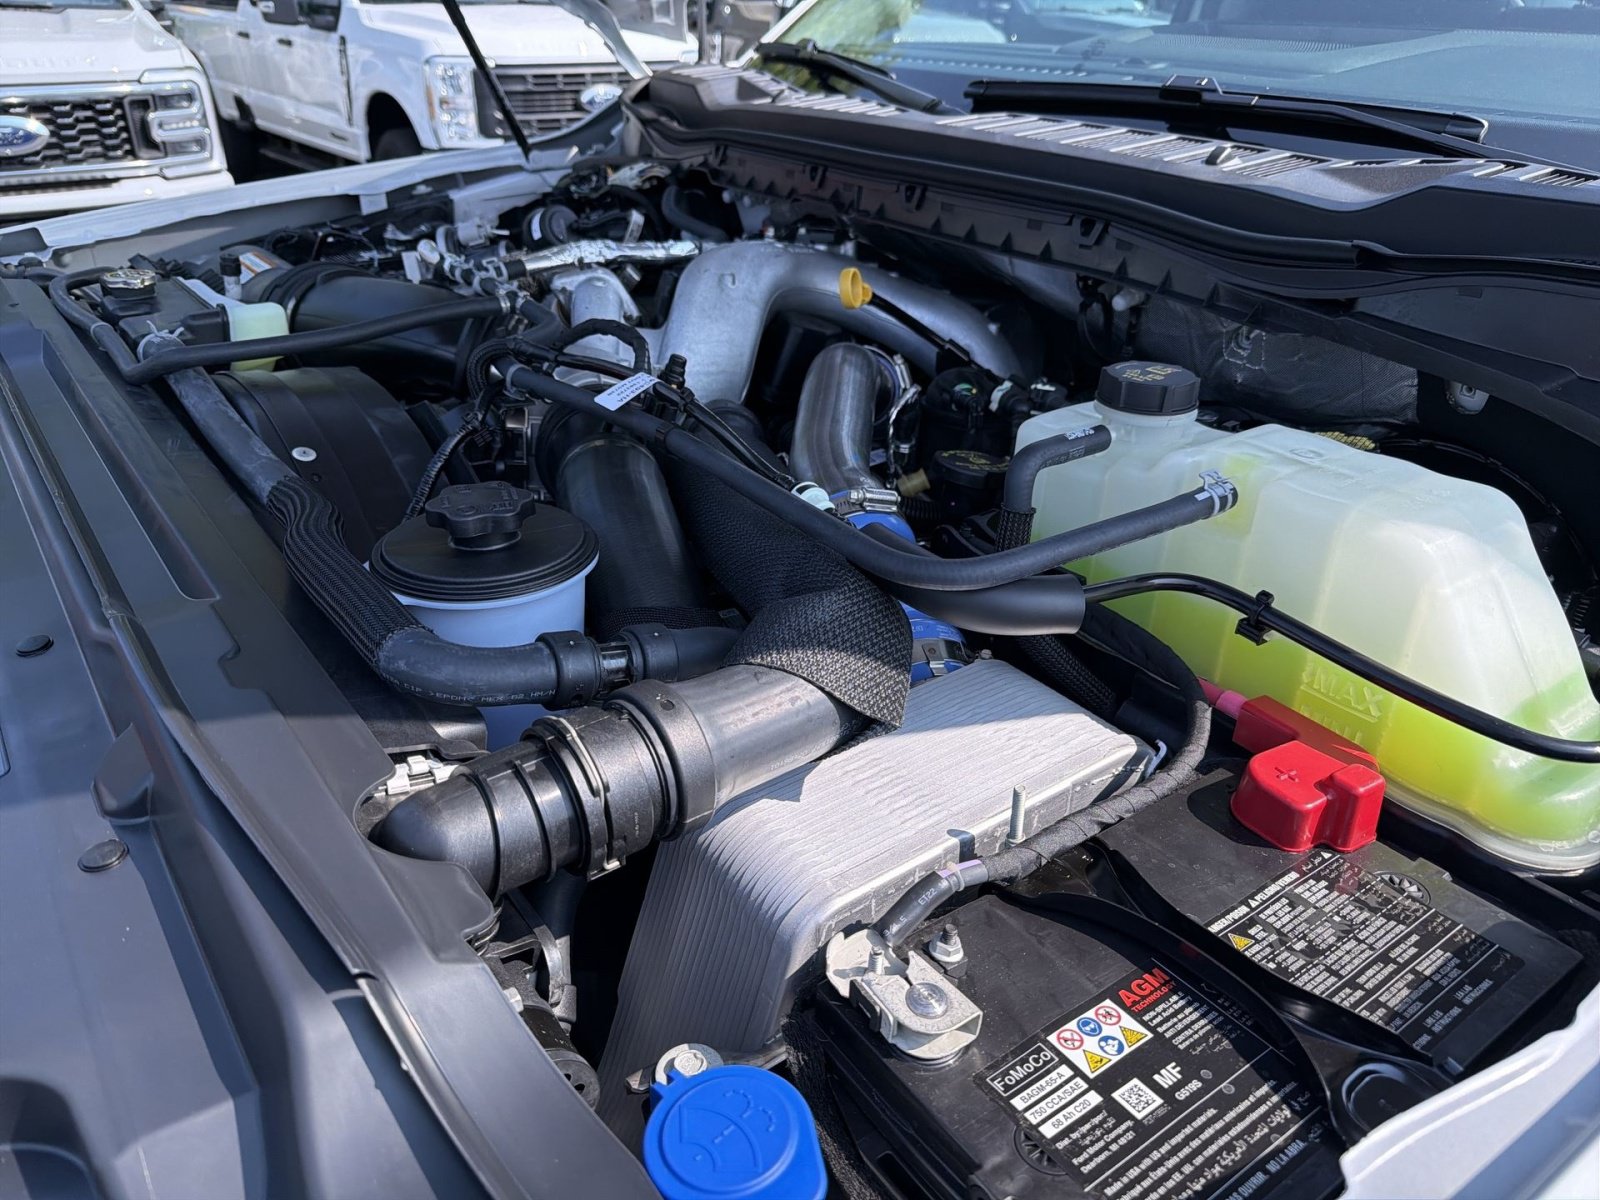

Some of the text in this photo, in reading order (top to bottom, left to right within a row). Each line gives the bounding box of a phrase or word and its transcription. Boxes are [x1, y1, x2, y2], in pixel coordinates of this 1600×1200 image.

[1313, 667, 1383, 718] MAX
[1207, 905, 1250, 934] ANGER/POISON
[1118, 968, 1169, 1007] AGM
[1131, 981, 1176, 1012] TECHNOLOGY
[1142, 992, 1184, 1021] NON-SPILLABLE
[993, 1051, 1051, 1091] FoMoCo
[1153, 1061, 1183, 1088] MF
[1020, 1072, 1065, 1103] BAGM-65-A
[1030, 1082, 1083, 1119] 750 CCA/SAE
[1175, 1080, 1202, 1100] G519S
[1052, 1100, 1091, 1128] 68 Ah C20
[1072, 1152, 1089, 1165] Ford
[1086, 1140, 1106, 1154] Motor
[1109, 1143, 1120, 1152] MI
[1118, 1130, 1136, 1145] 48121
[1104, 1181, 1124, 1196] Made
[1120, 1176, 1130, 1184] in
[1126, 1166, 1142, 1179] USA
[1149, 1150, 1161, 1160] US
[1159, 1142, 1171, 1154] and
[1266, 1160, 1280, 1173] NO
[1275, 1153, 1289, 1165] LA
[1284, 1140, 1308, 1158] ABRA.
[1117, 1184, 1144, 1200] abriqué
